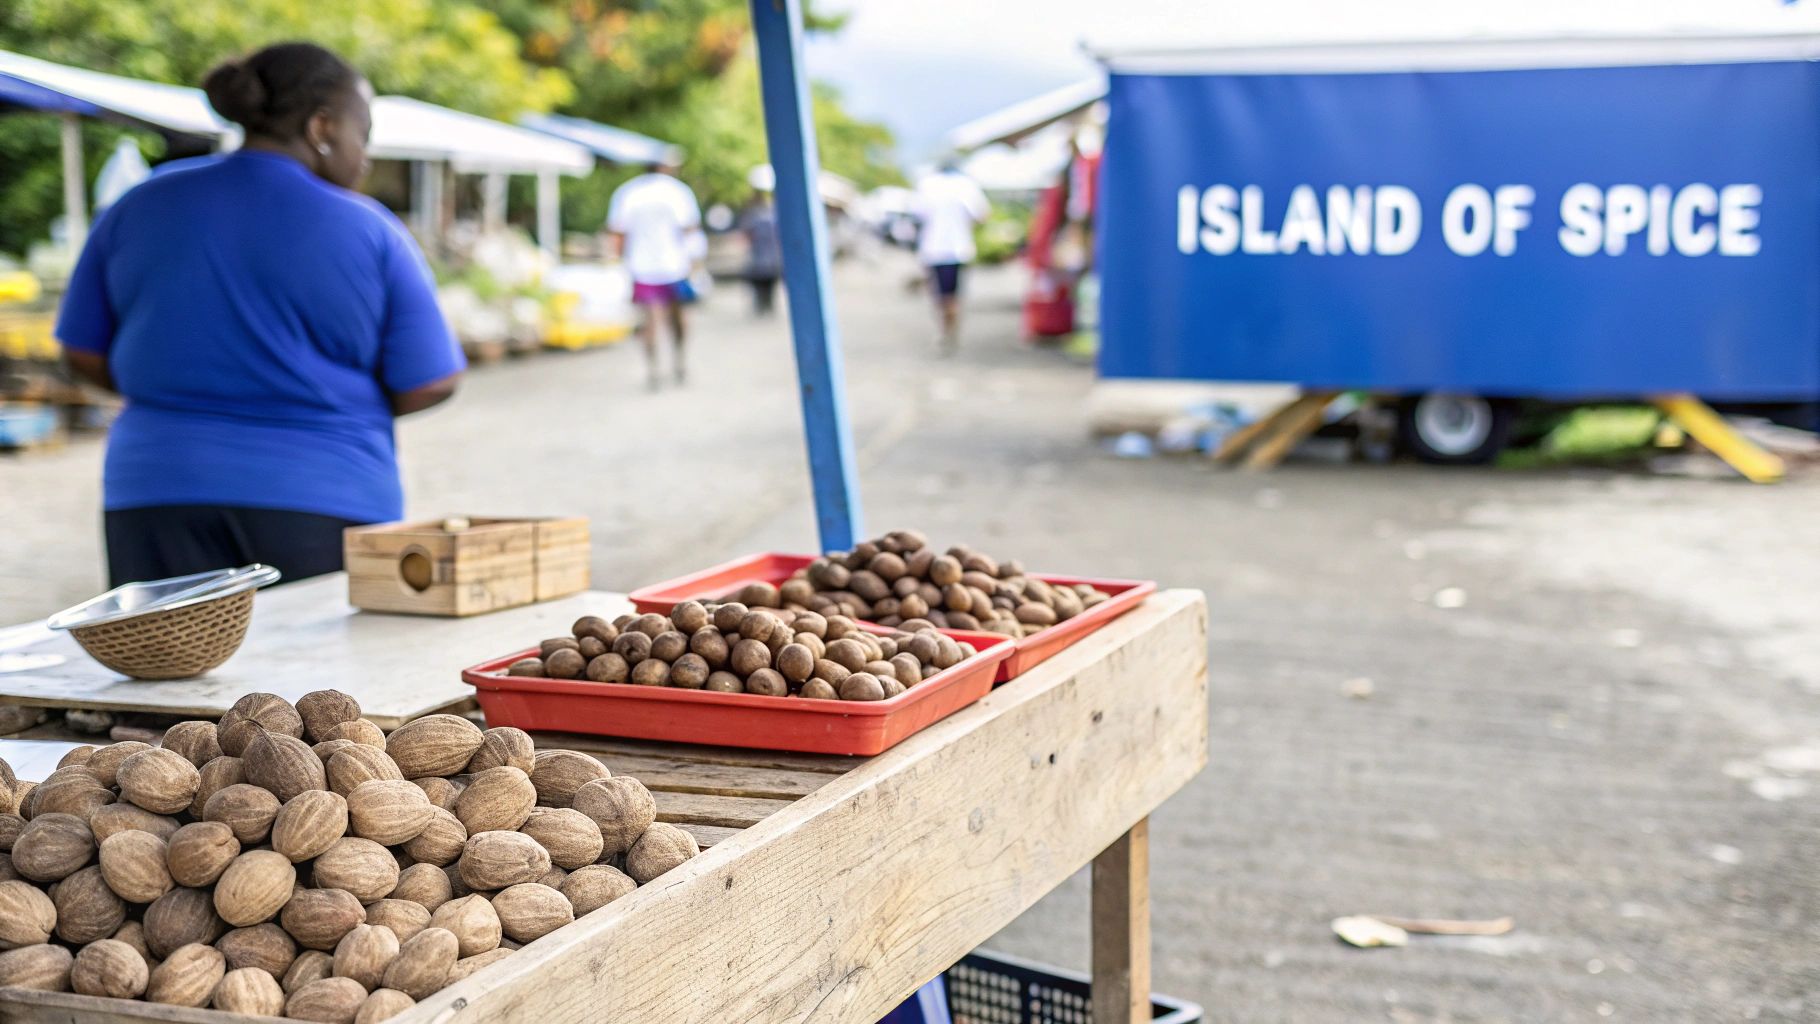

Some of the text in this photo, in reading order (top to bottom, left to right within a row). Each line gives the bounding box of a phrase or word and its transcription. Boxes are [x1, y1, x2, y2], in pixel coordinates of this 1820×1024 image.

[1177, 183, 1762, 256] ISLAND OF SPICE
